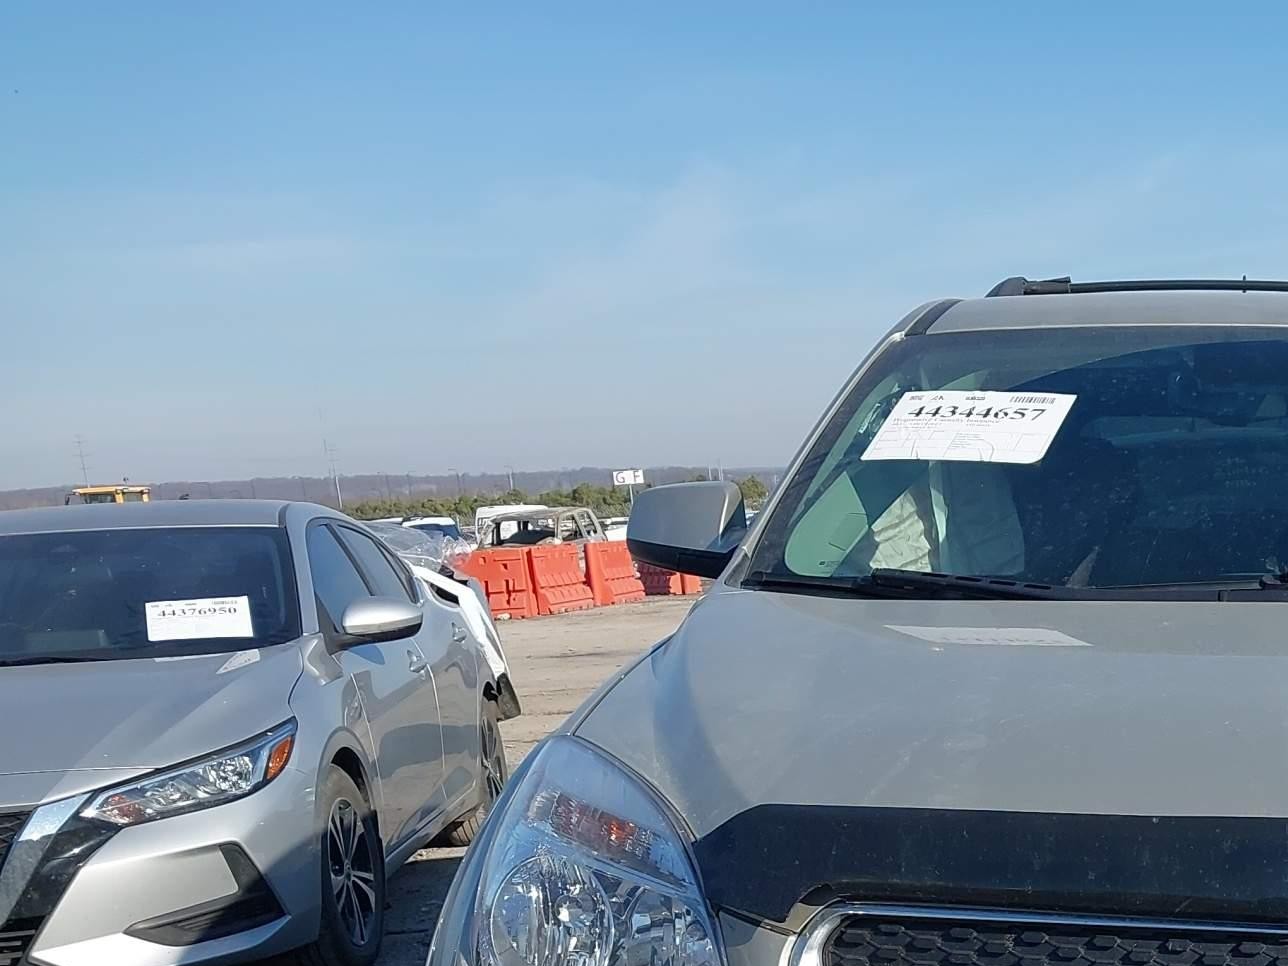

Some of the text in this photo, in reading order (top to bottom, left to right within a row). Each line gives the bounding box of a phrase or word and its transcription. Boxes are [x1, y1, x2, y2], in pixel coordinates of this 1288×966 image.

[907, 405, 1047, 421] 44344657
[615, 471, 625, 483] G
[157, 606, 238, 617] 44376950
